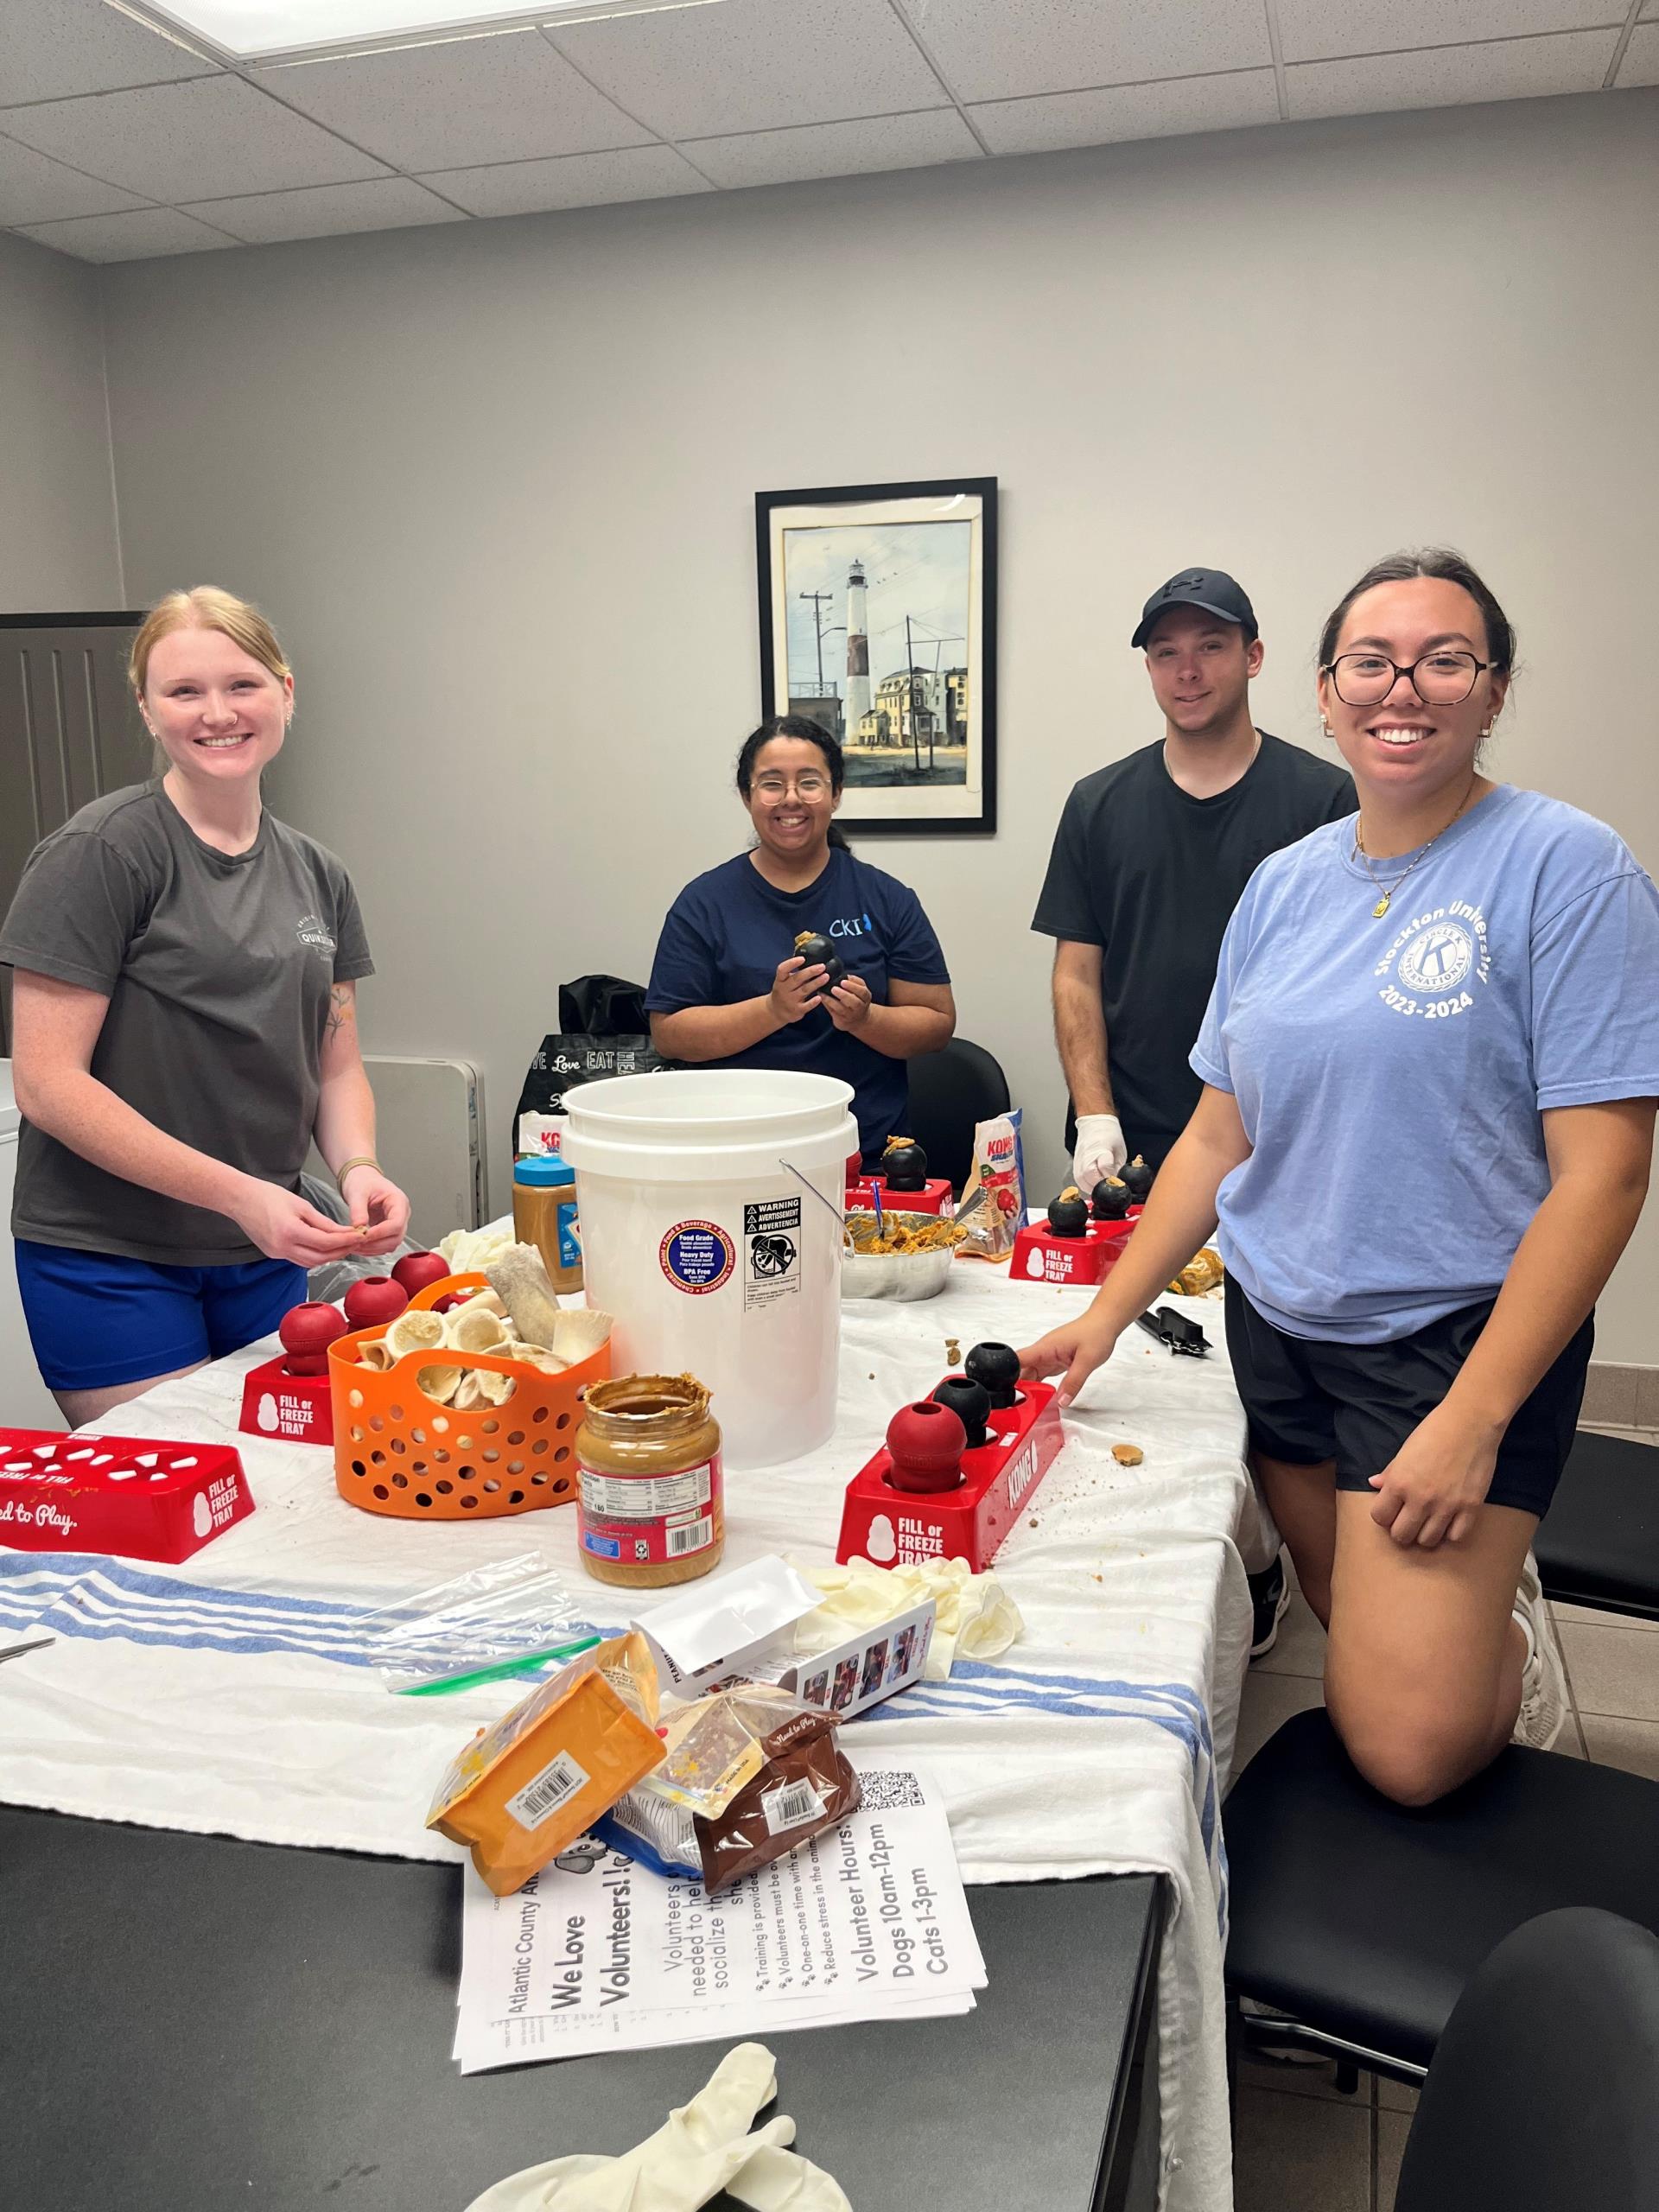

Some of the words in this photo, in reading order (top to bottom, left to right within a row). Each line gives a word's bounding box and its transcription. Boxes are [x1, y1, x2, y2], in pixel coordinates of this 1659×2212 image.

[830, 918, 863, 938] CKI
[1448, 899, 1491, 984] University
[1405, 953, 1466, 985] INTERNATIONAL
[1379, 985, 1473, 1019] 2023-2024
[551, 1054, 581, 1074] Love
[587, 1051, 615, 1069] EAT
[987, 1137, 1013, 1157] KONG
[758, 1208, 799, 1223] AVERTISSEMENT
[759, 1199, 799, 1212] WARNING
[759, 1217, 798, 1231] ADVERTENCIA
[1046, 1249, 1062, 1262] FILL
[1046, 1260, 1073, 1273] FREEZE
[1045, 1269, 1065, 1281] TRAY
[280, 1395, 300, 1408] FILL
[301, 1400, 313, 1410] or
[280, 1408, 314, 1424] FREEZE
[280, 1421, 305, 1435] TRAY
[208, 1477, 226, 1499] FILL
[226, 1473, 236, 1486] or
[1007, 1448, 1031, 1510] KONG
[211, 1484, 239, 1514] FREEZE
[15, 1502, 34, 1522] to
[35, 1503, 78, 1535] Play.
[213, 1506, 234, 1528] TRAY
[898, 1517, 925, 1535] FILL
[928, 1524, 943, 1537] or
[898, 1534, 944, 1554] FREEZE
[664, 1654, 682, 1684] PEANUT
[776, 1726, 794, 1743] Need
[800, 1717, 817, 1729] Play
[836, 1824, 861, 1882] Hours:
[767, 1872, 779, 1889] be
[787, 1861, 802, 1885] with
[810, 1865, 821, 1882] the
[868, 1823, 903, 1923] 10am-12pm
[771, 1889, 784, 1916] must
[792, 1885, 804, 1910] time
[813, 1884, 823, 1894] in
[911, 1867, 938, 1923] 1-3pm
[703, 1894, 723, 1913] th
[816, 1896, 830, 1928] stress
[515, 1901, 541, 1953] County
[662, 1885, 683, 1973] Volunteers
[686, 1913, 702, 1930] to
[752, 1922, 764, 1932] is
[850, 1886, 879, 1982] Volunteer
[554, 1915, 586, 1967] Love
[705, 1917, 729, 1989] socialize
[775, 1918, 791, 1975] Volunteers
[798, 1911, 814, 1973] One-on-one
[821, 1929, 836, 1970] Reduce
[891, 1927, 916, 1978] Dogs
[923, 1926, 949, 1974] Cats
[683, 1936, 707, 1997] needed
[752, 1934, 768, 1978] Training
[508, 1956, 531, 2013] Atlantic
[551, 1969, 582, 2011] We
